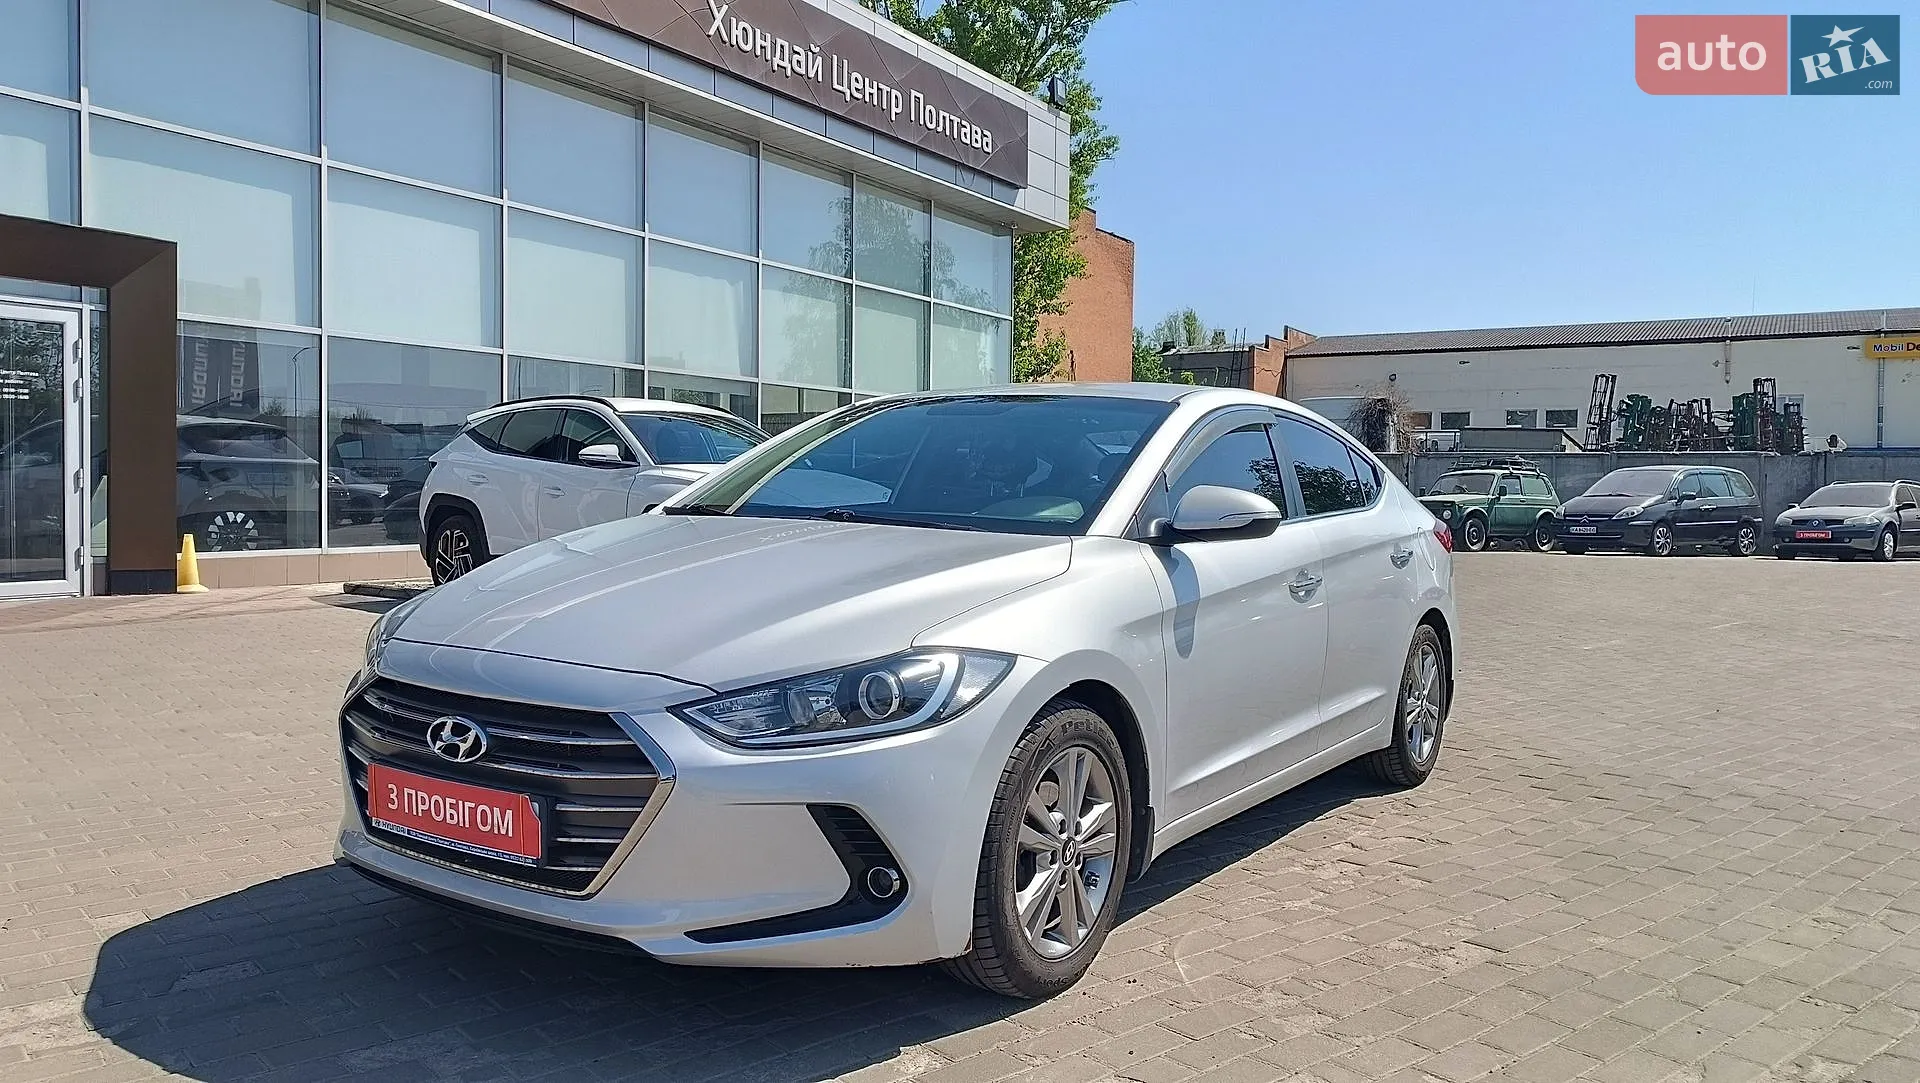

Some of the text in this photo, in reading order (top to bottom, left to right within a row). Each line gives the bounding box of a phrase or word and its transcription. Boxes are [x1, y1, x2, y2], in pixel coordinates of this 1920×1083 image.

[707, 0, 994, 154] Хюндай Центр Полтава
[1873, 343, 1903, 352] Mobil
[387, 783, 513, 838] З ПРОБІГОМ
